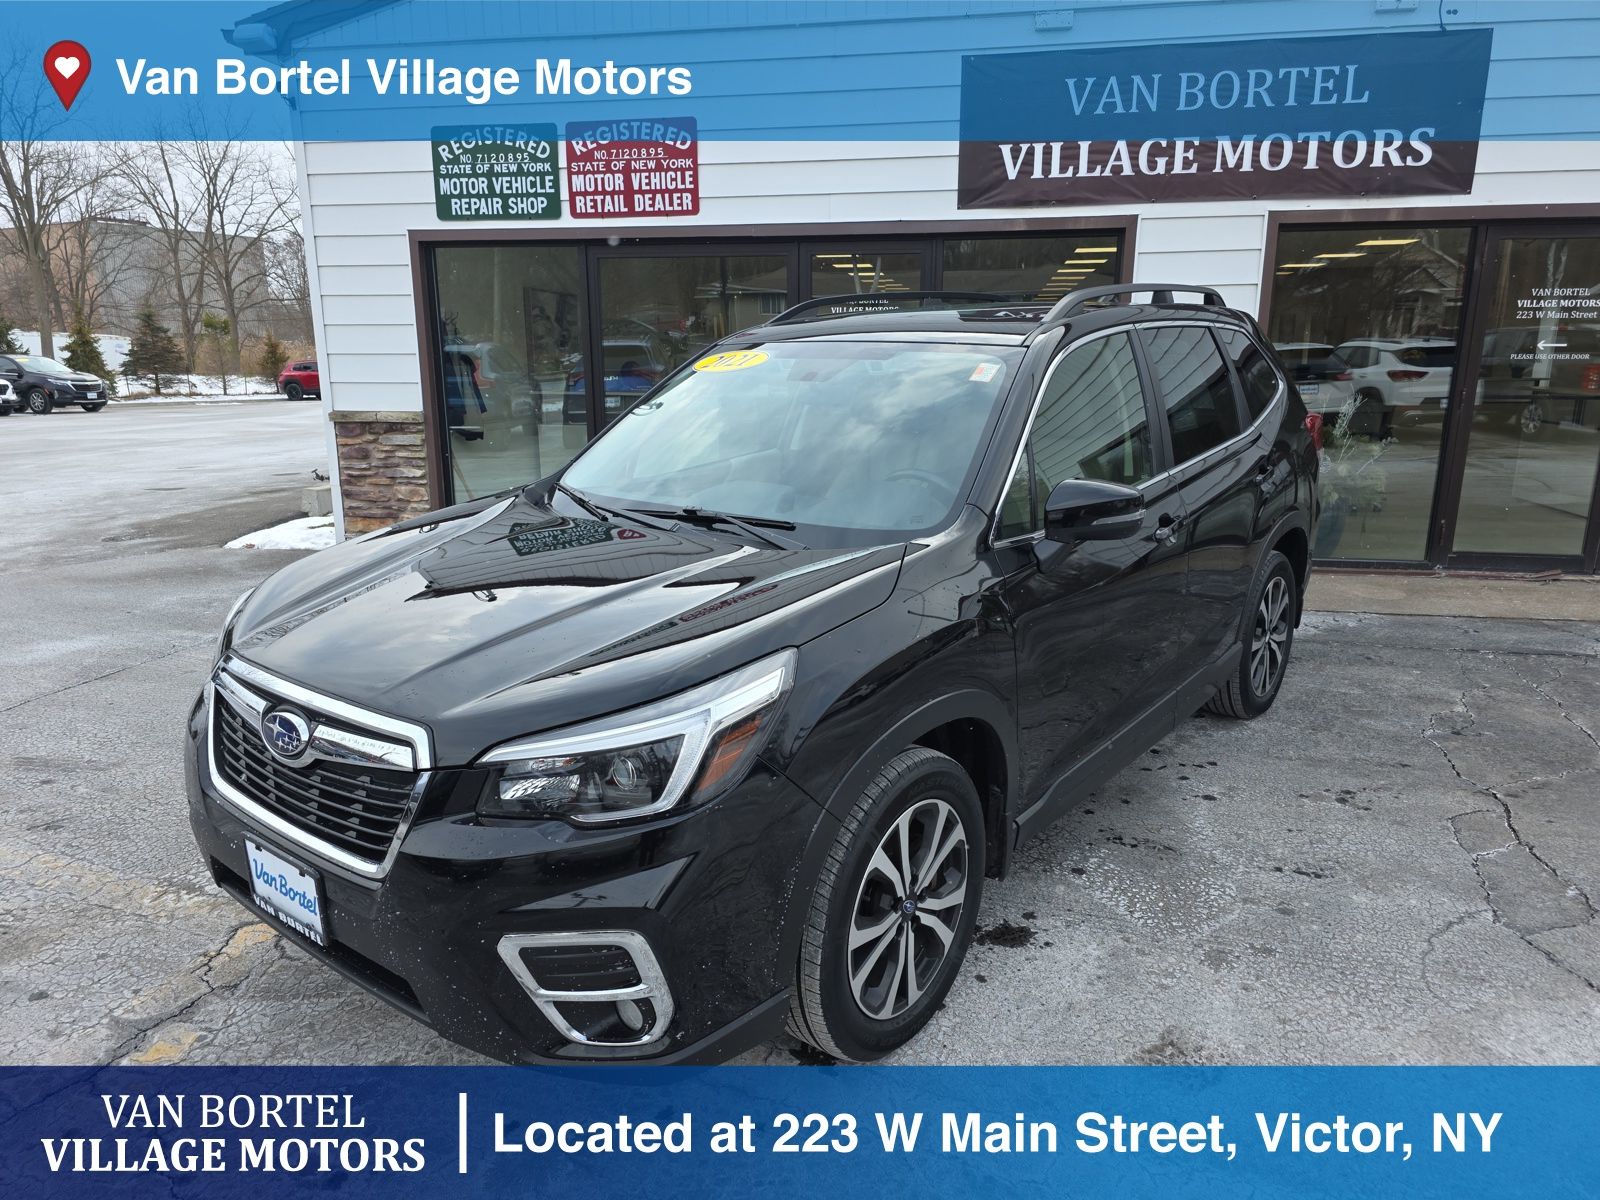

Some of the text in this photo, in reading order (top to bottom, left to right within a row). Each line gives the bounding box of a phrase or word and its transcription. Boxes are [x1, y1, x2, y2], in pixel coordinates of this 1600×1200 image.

[1065, 64, 1370, 116] VAN BORTEL
[438, 126, 551, 162] REGISTERED
[571, 122, 692, 156] REGISTERED
[476, 153, 530, 163] 7120895
[611, 148, 664, 159] 7120895
[998, 127, 1436, 180] VILLAGE MOTORS
[440, 163, 551, 173] STATE OF NEW YORK
[571, 159, 693, 172] STATE OF NEW YORK
[440, 176, 555, 195] MOTOR VEHICLE
[572, 171, 694, 192] MOTOR VEHICLE
[451, 197, 547, 215] REPAIR SHOP
[576, 193, 692, 213] RETAIL DEALER
[1532, 288, 1590, 296] VAN BORTEL
[1517, 300, 1558, 308] VILLAGE
